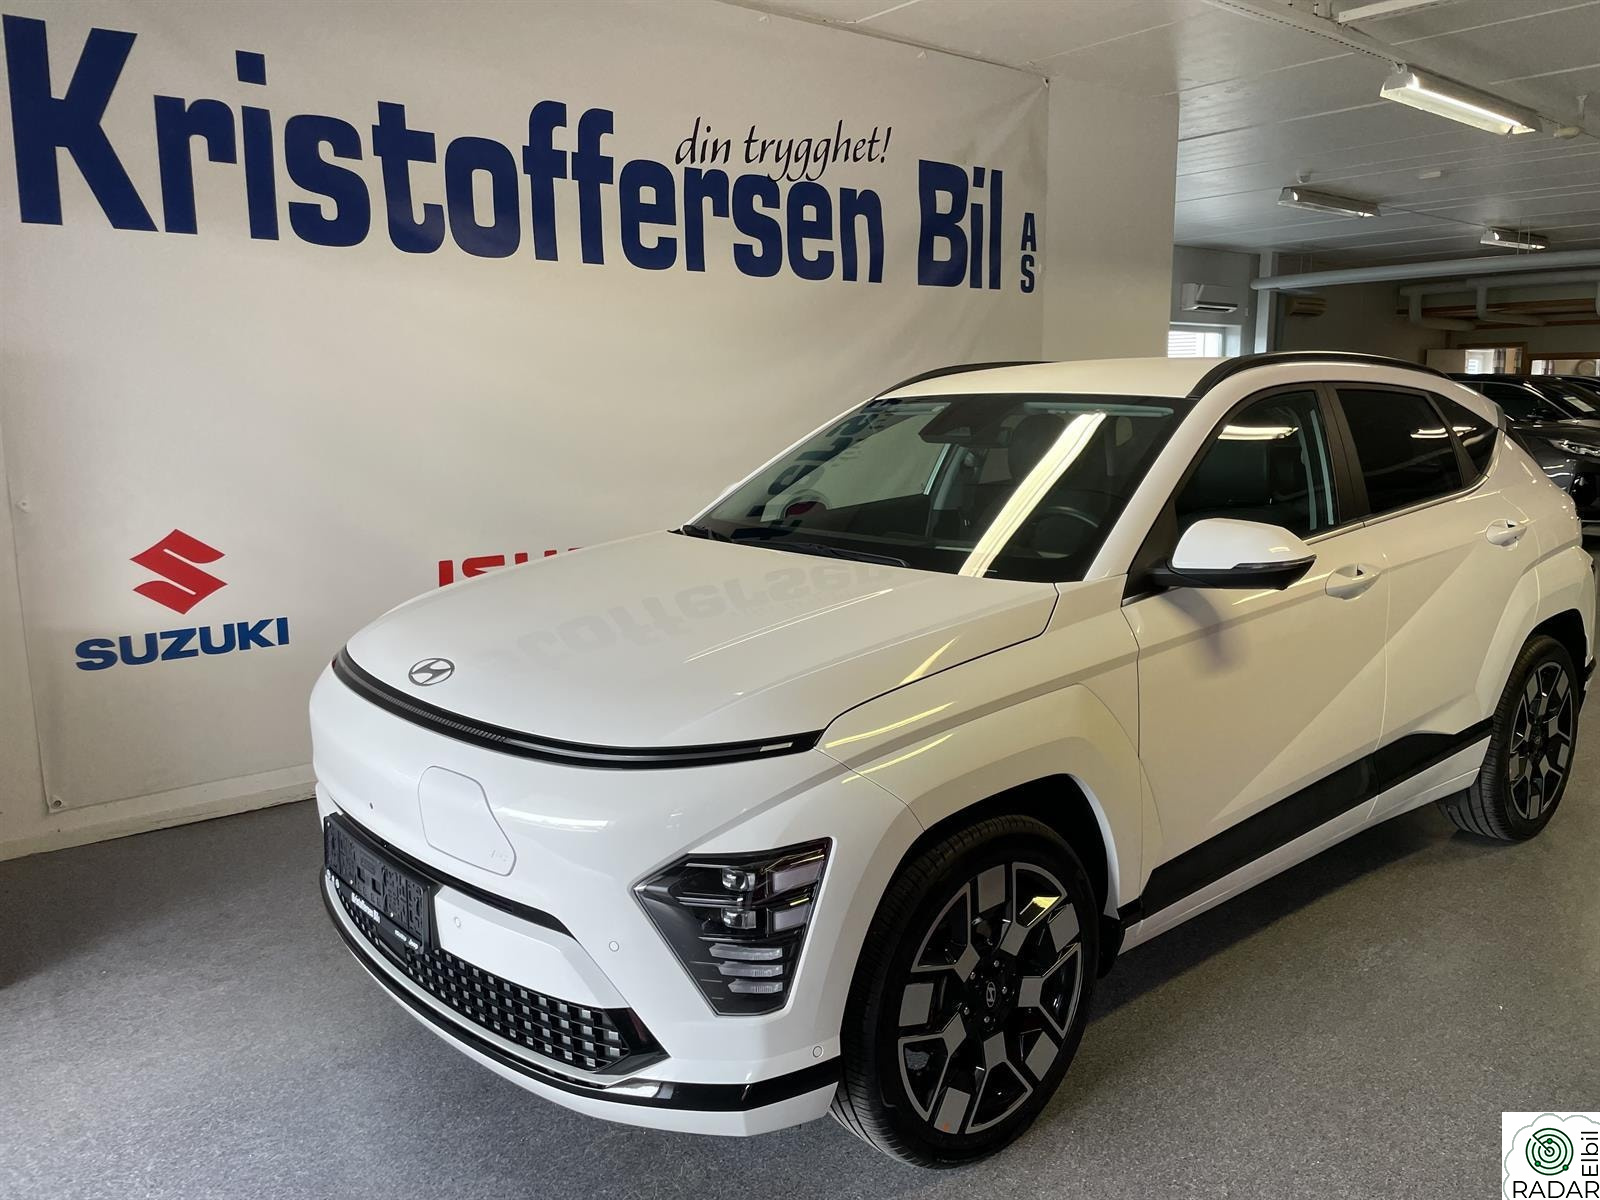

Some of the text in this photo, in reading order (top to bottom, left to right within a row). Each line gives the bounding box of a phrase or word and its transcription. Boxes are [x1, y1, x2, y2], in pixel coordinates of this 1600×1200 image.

[2, 14, 1003, 290] Kristoffersen Bil
[674, 116, 892, 182] din trygghet!
[75, 616, 290, 671] SUZUKI
